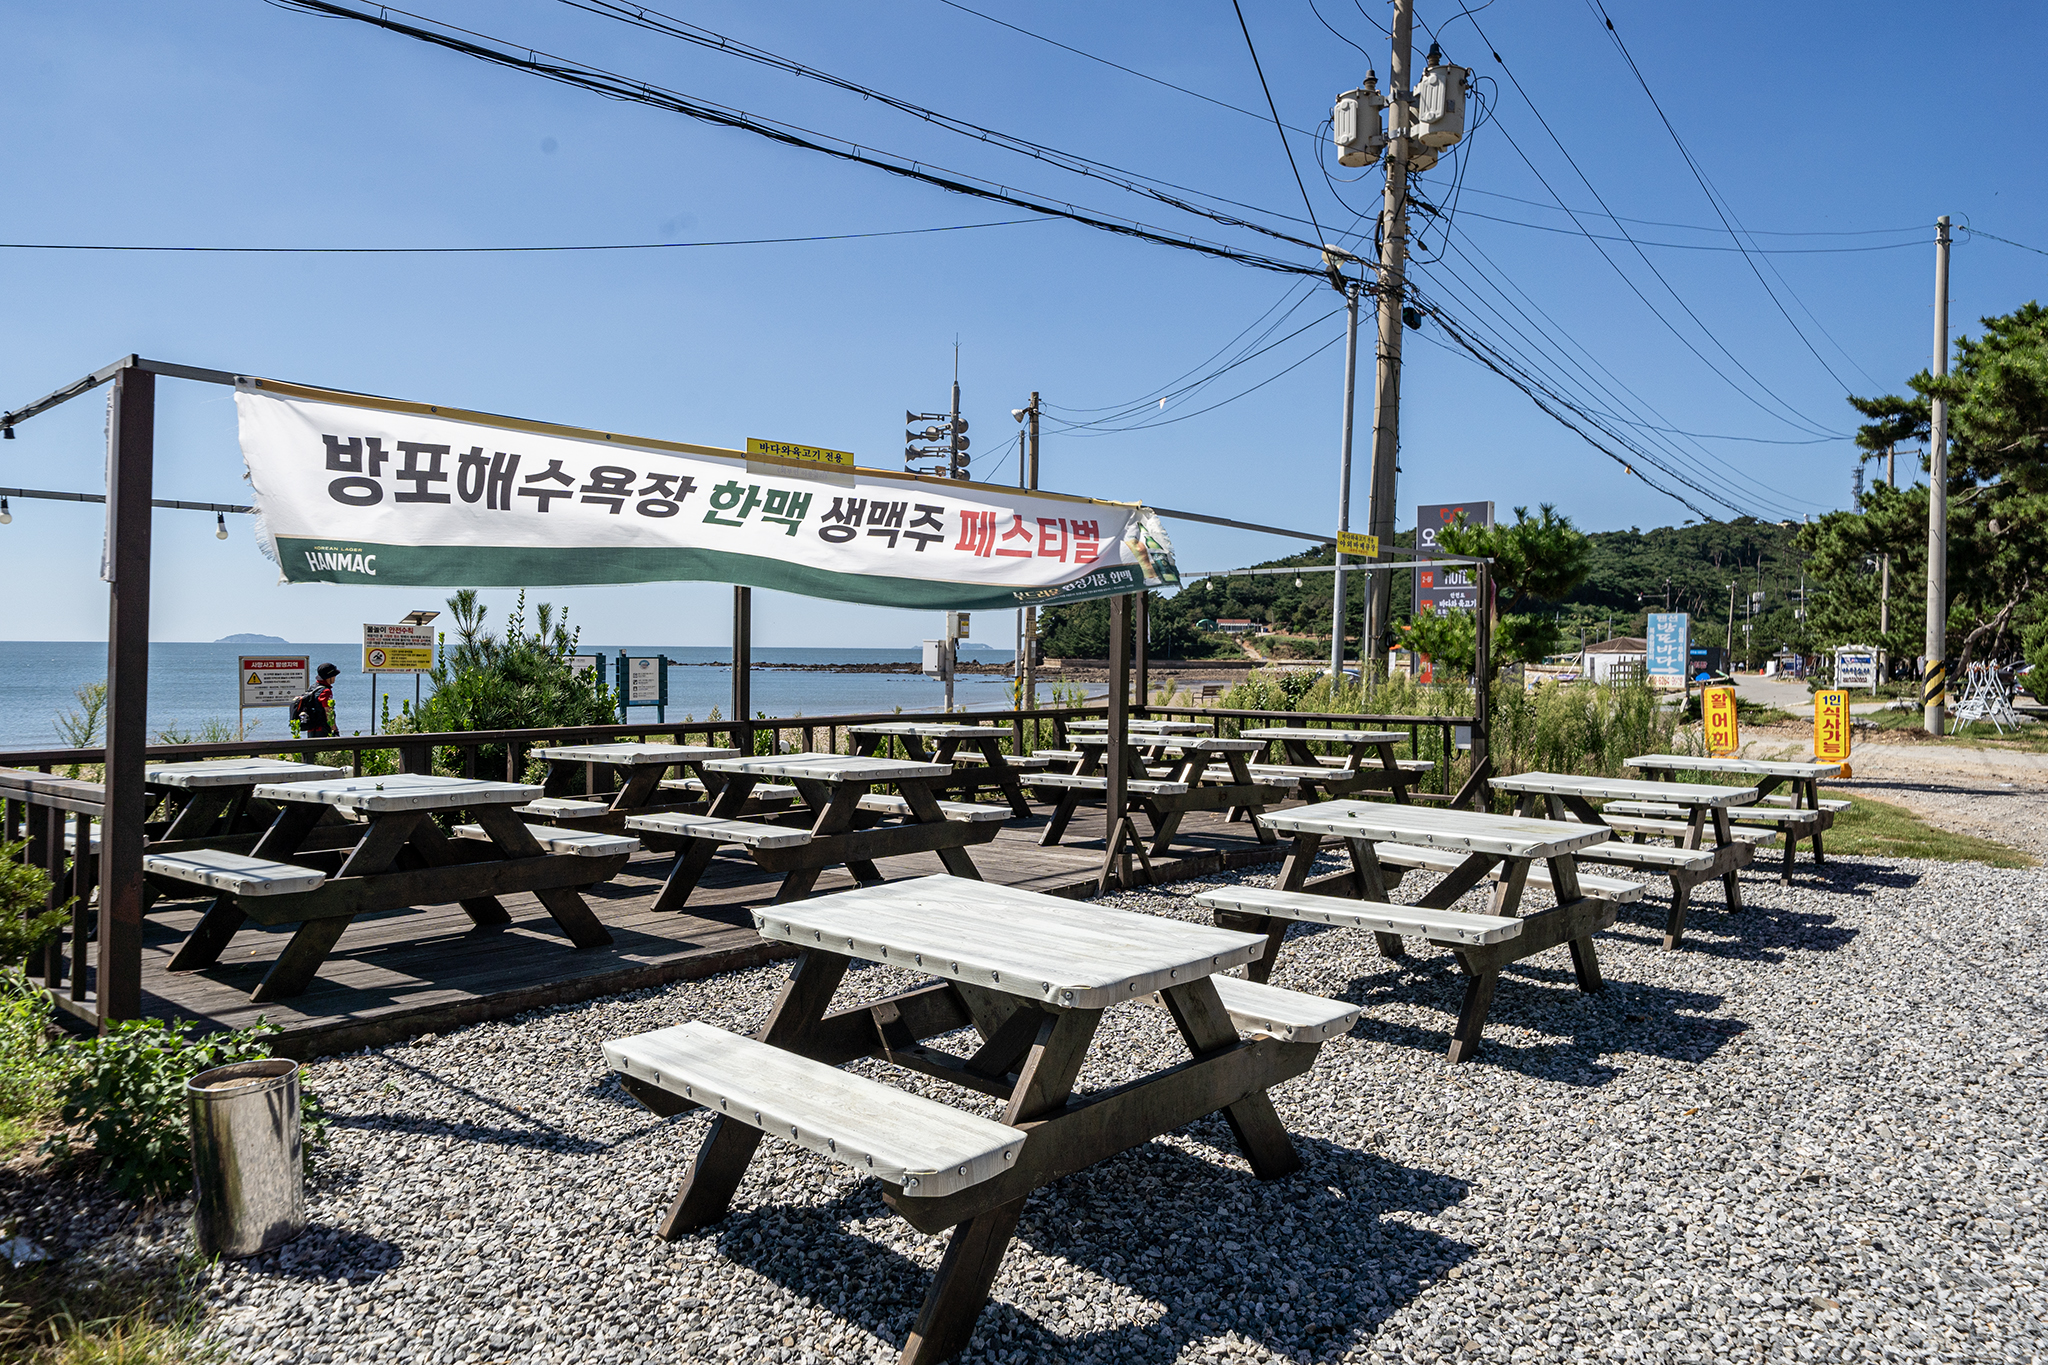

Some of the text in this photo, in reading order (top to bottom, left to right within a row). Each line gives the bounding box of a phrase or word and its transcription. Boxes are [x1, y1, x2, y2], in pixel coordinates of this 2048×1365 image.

[759, 442, 821, 460] 바다와육고기
[825, 451, 843, 464] 전용
[321, 433, 1101, 565] 방포해수욕장 한맥 생맥주 페스티벌
[304, 551, 376, 576] HANMAC
[389, 626, 414, 634] 안전수칙
[1823, 695, 1841, 706] 1인
[1710, 693, 1728, 747] 활어회
[1823, 707, 1841, 753] 식사가능
